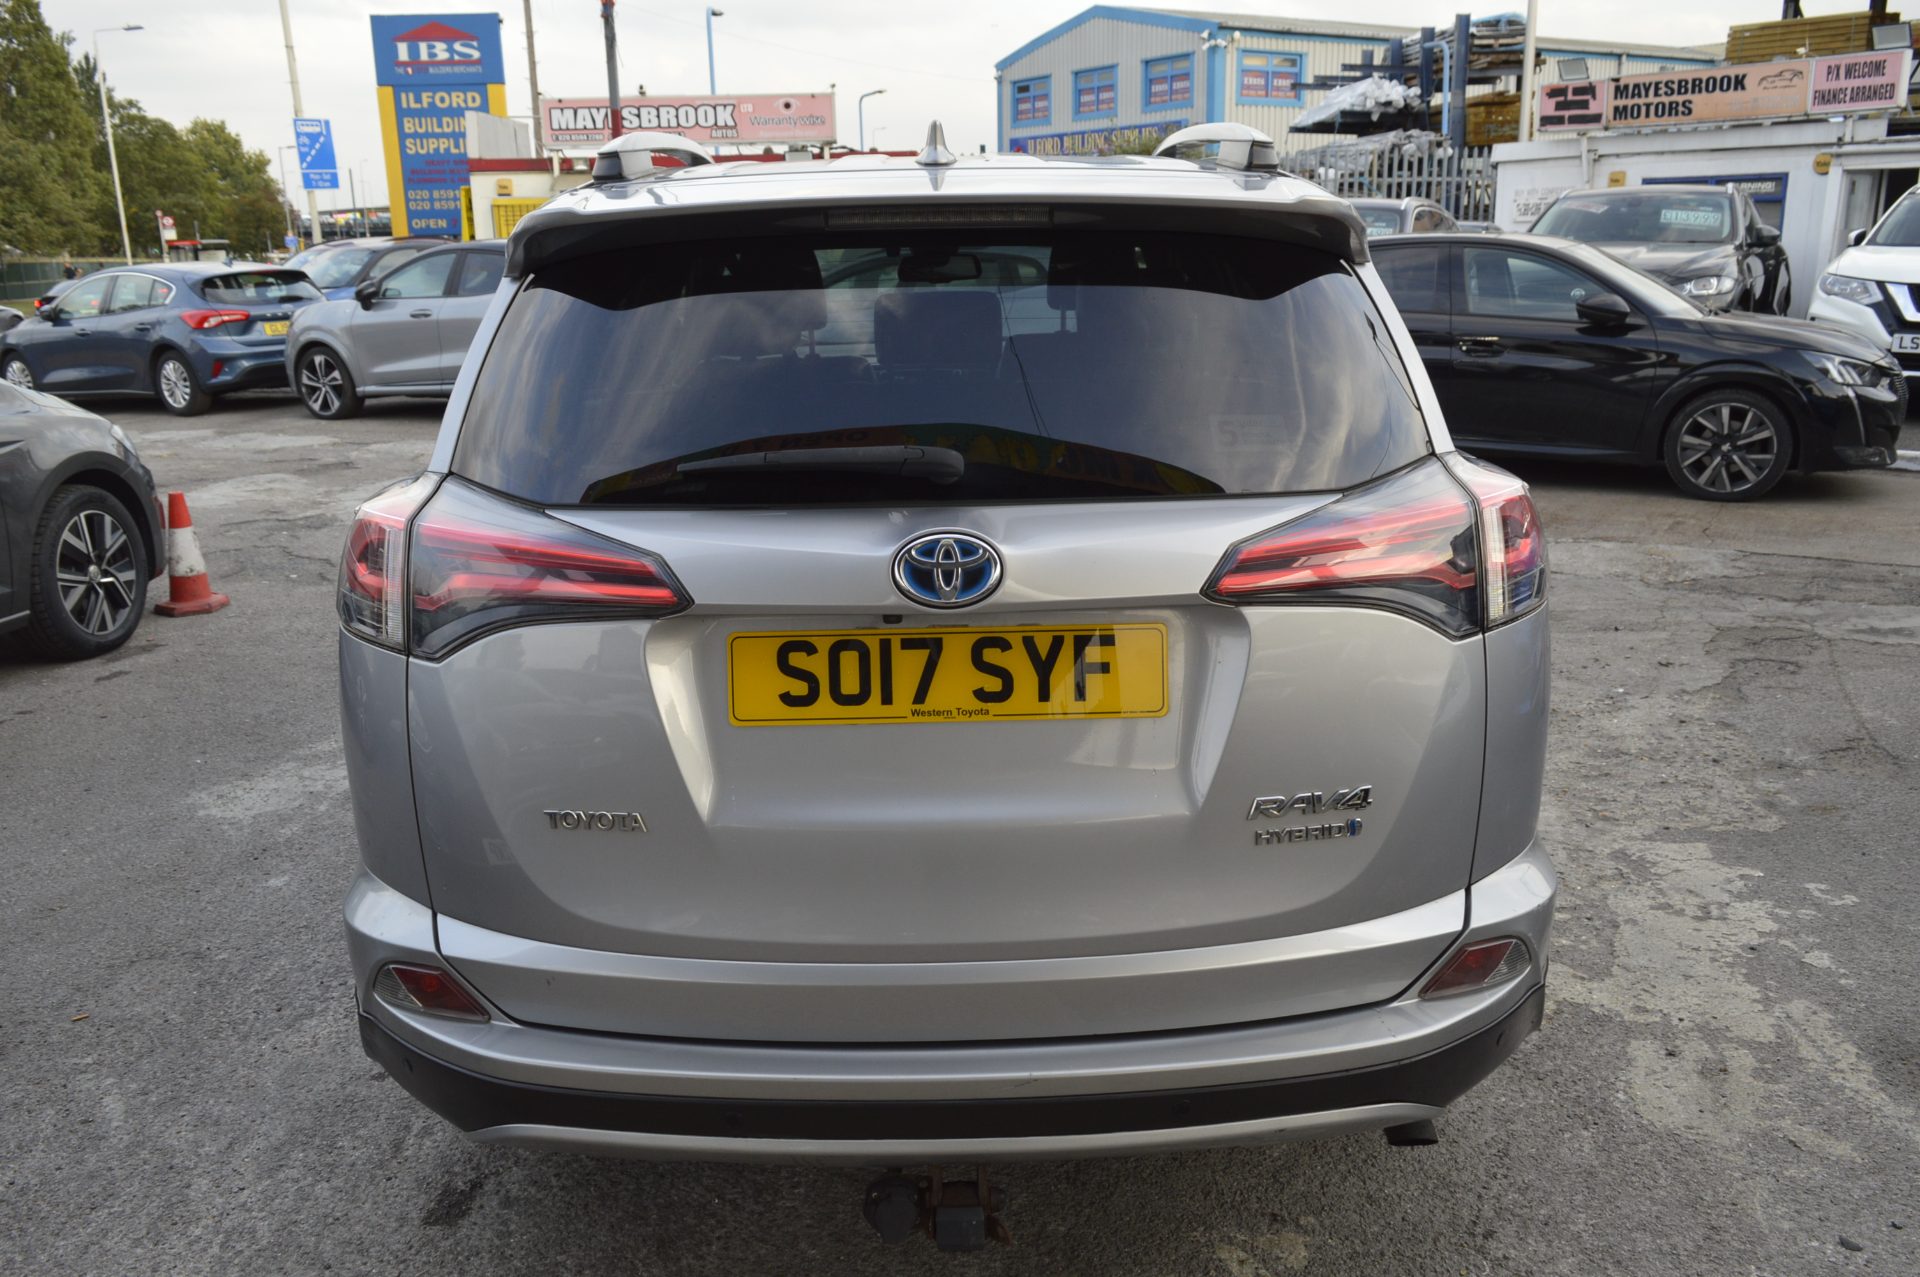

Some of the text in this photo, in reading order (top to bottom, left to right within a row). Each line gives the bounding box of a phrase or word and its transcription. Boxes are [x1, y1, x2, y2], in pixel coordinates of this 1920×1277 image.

[395, 40, 482, 62] IBS
[1826, 59, 1887, 82] P/X WELCOME
[1614, 73, 1748, 101] MAYESBROOK
[1813, 87, 1849, 107] FINANCE
[1848, 83, 1896, 103] ARRANGED
[400, 91, 482, 109] ILFORD
[1613, 99, 1694, 121] MOTORS
[549, 103, 737, 131] MAYSBROOK
[749, 115, 798, 128] Warranty
[710, 127, 739, 139] AUTOS
[408, 190, 430, 200] 020
[409, 201, 431, 210] 020
[412, 218, 447, 229] OPEN
[776, 634, 1115, 708] SO17 SYF
[911, 707, 990, 718] Western Toyota
[1246, 785, 1373, 820] RAV4
[543, 809, 648, 833] TOYOTA
[1255, 823, 1345, 846] HYBRID
